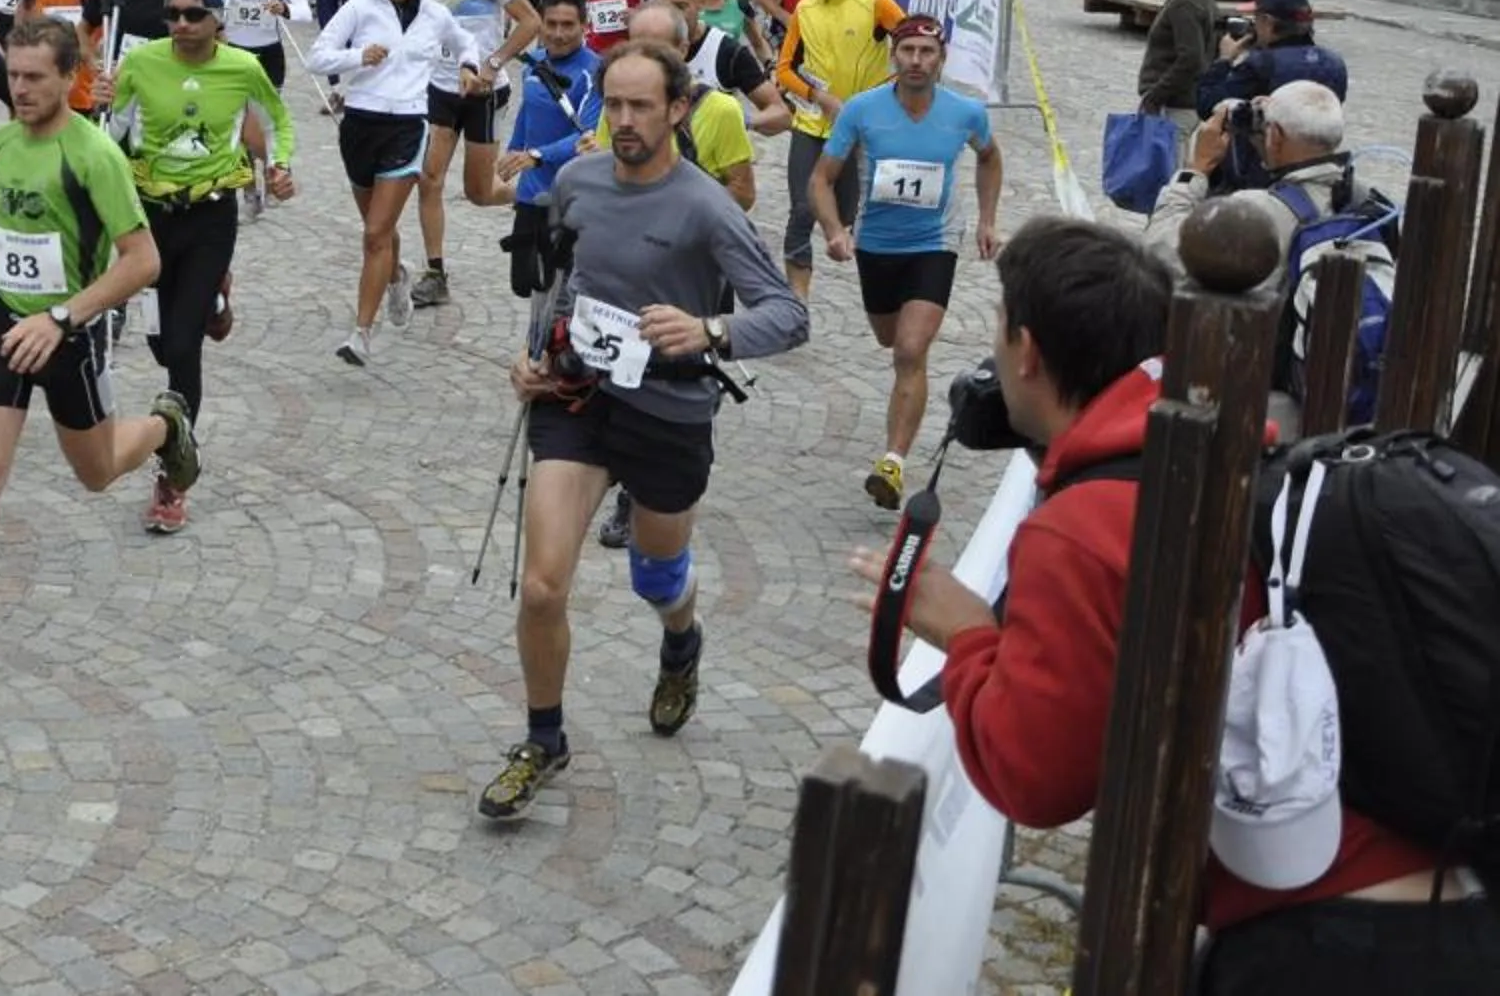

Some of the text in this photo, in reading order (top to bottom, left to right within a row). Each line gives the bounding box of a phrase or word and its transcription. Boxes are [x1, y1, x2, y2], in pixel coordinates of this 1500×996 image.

[239, 7, 261, 21] 92
[893, 177, 922, 197] 11
[5, 251, 40, 280] 83
[889, 533, 922, 592] Canon
